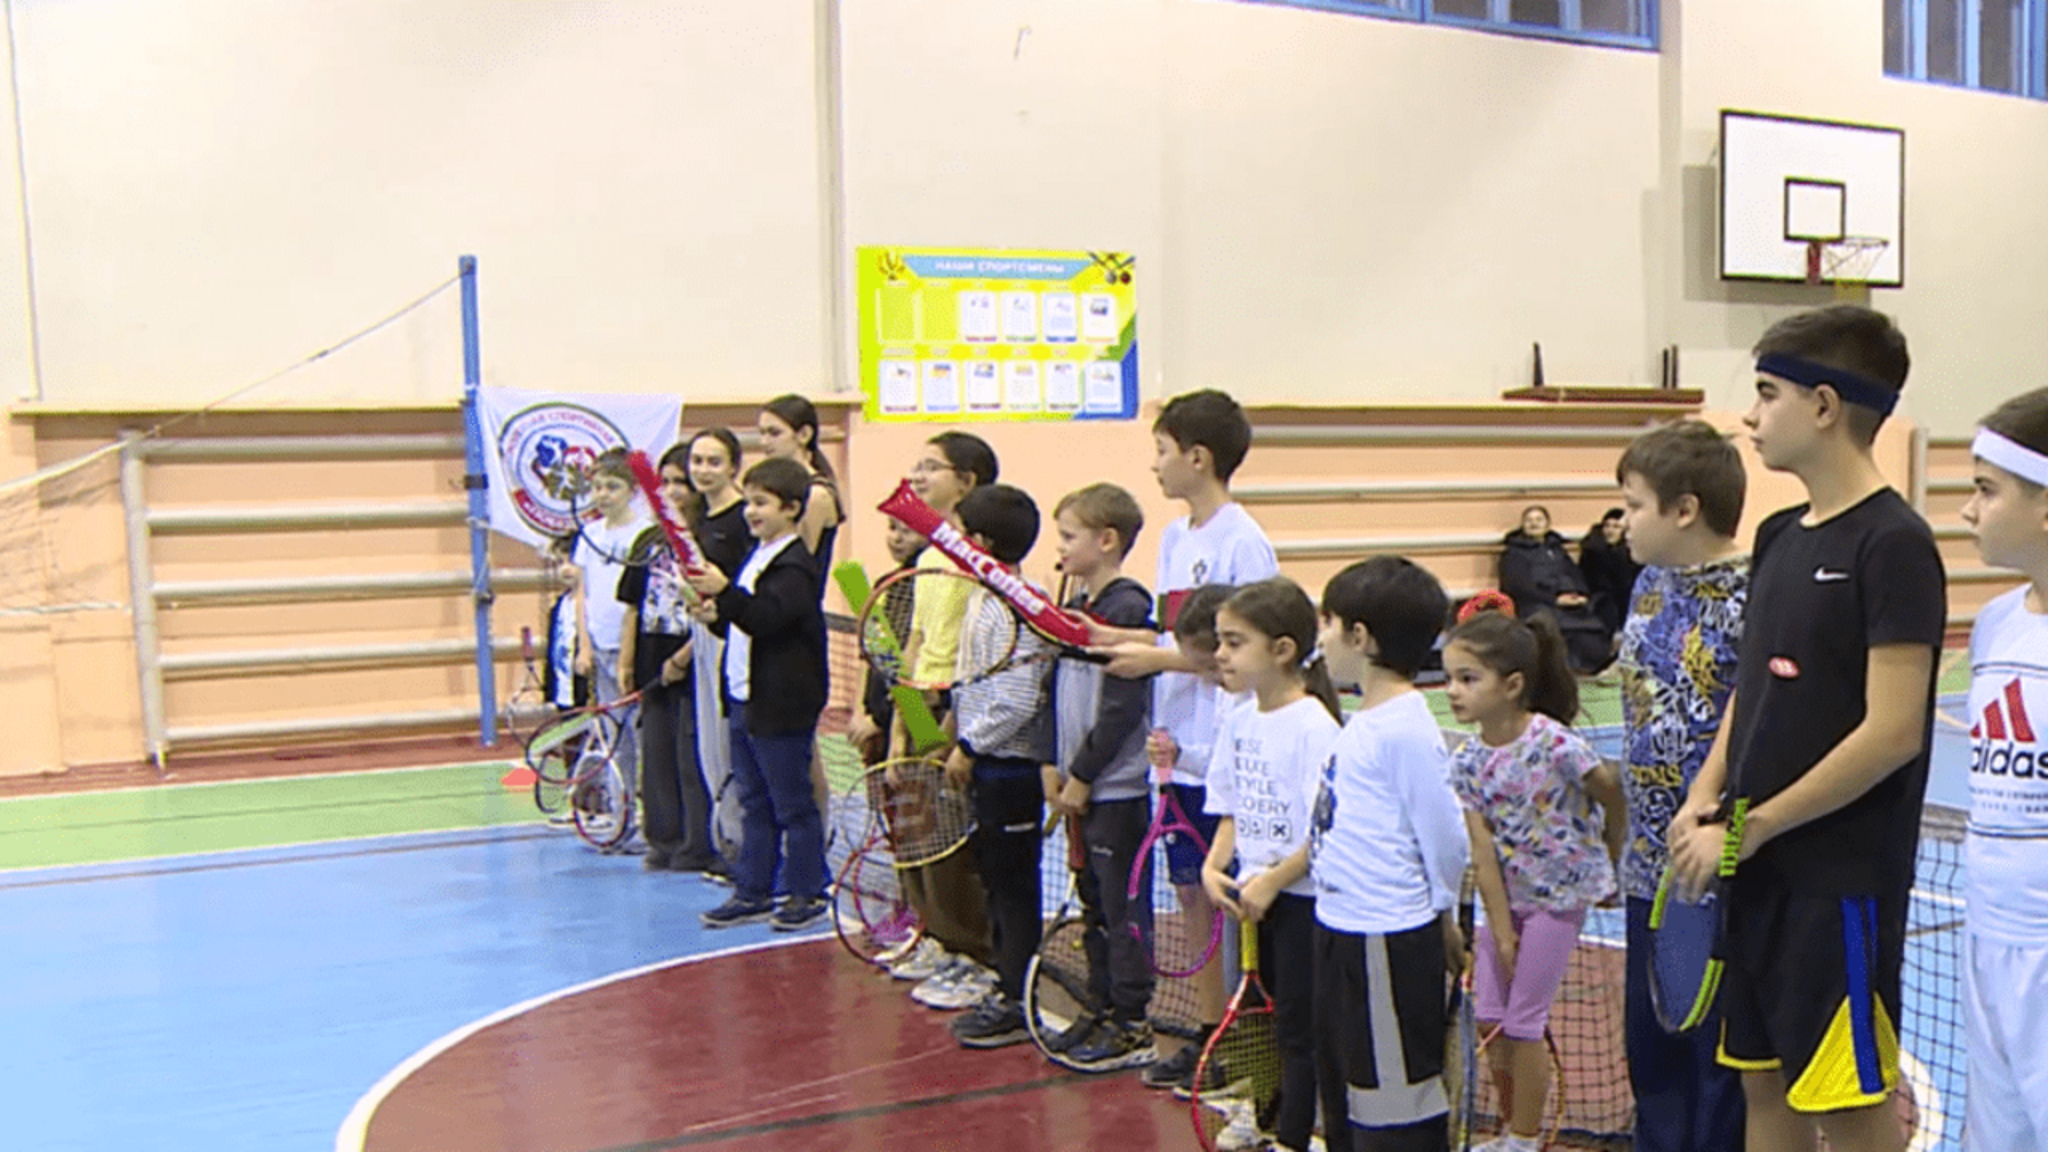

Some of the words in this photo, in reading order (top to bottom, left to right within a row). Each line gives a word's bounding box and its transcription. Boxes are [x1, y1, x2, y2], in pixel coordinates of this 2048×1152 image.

[935, 261, 975, 271] НАШИ
[978, 261, 1065, 274] СПОРТСМЕНЫ
[1970, 739, 2048, 779] didas
